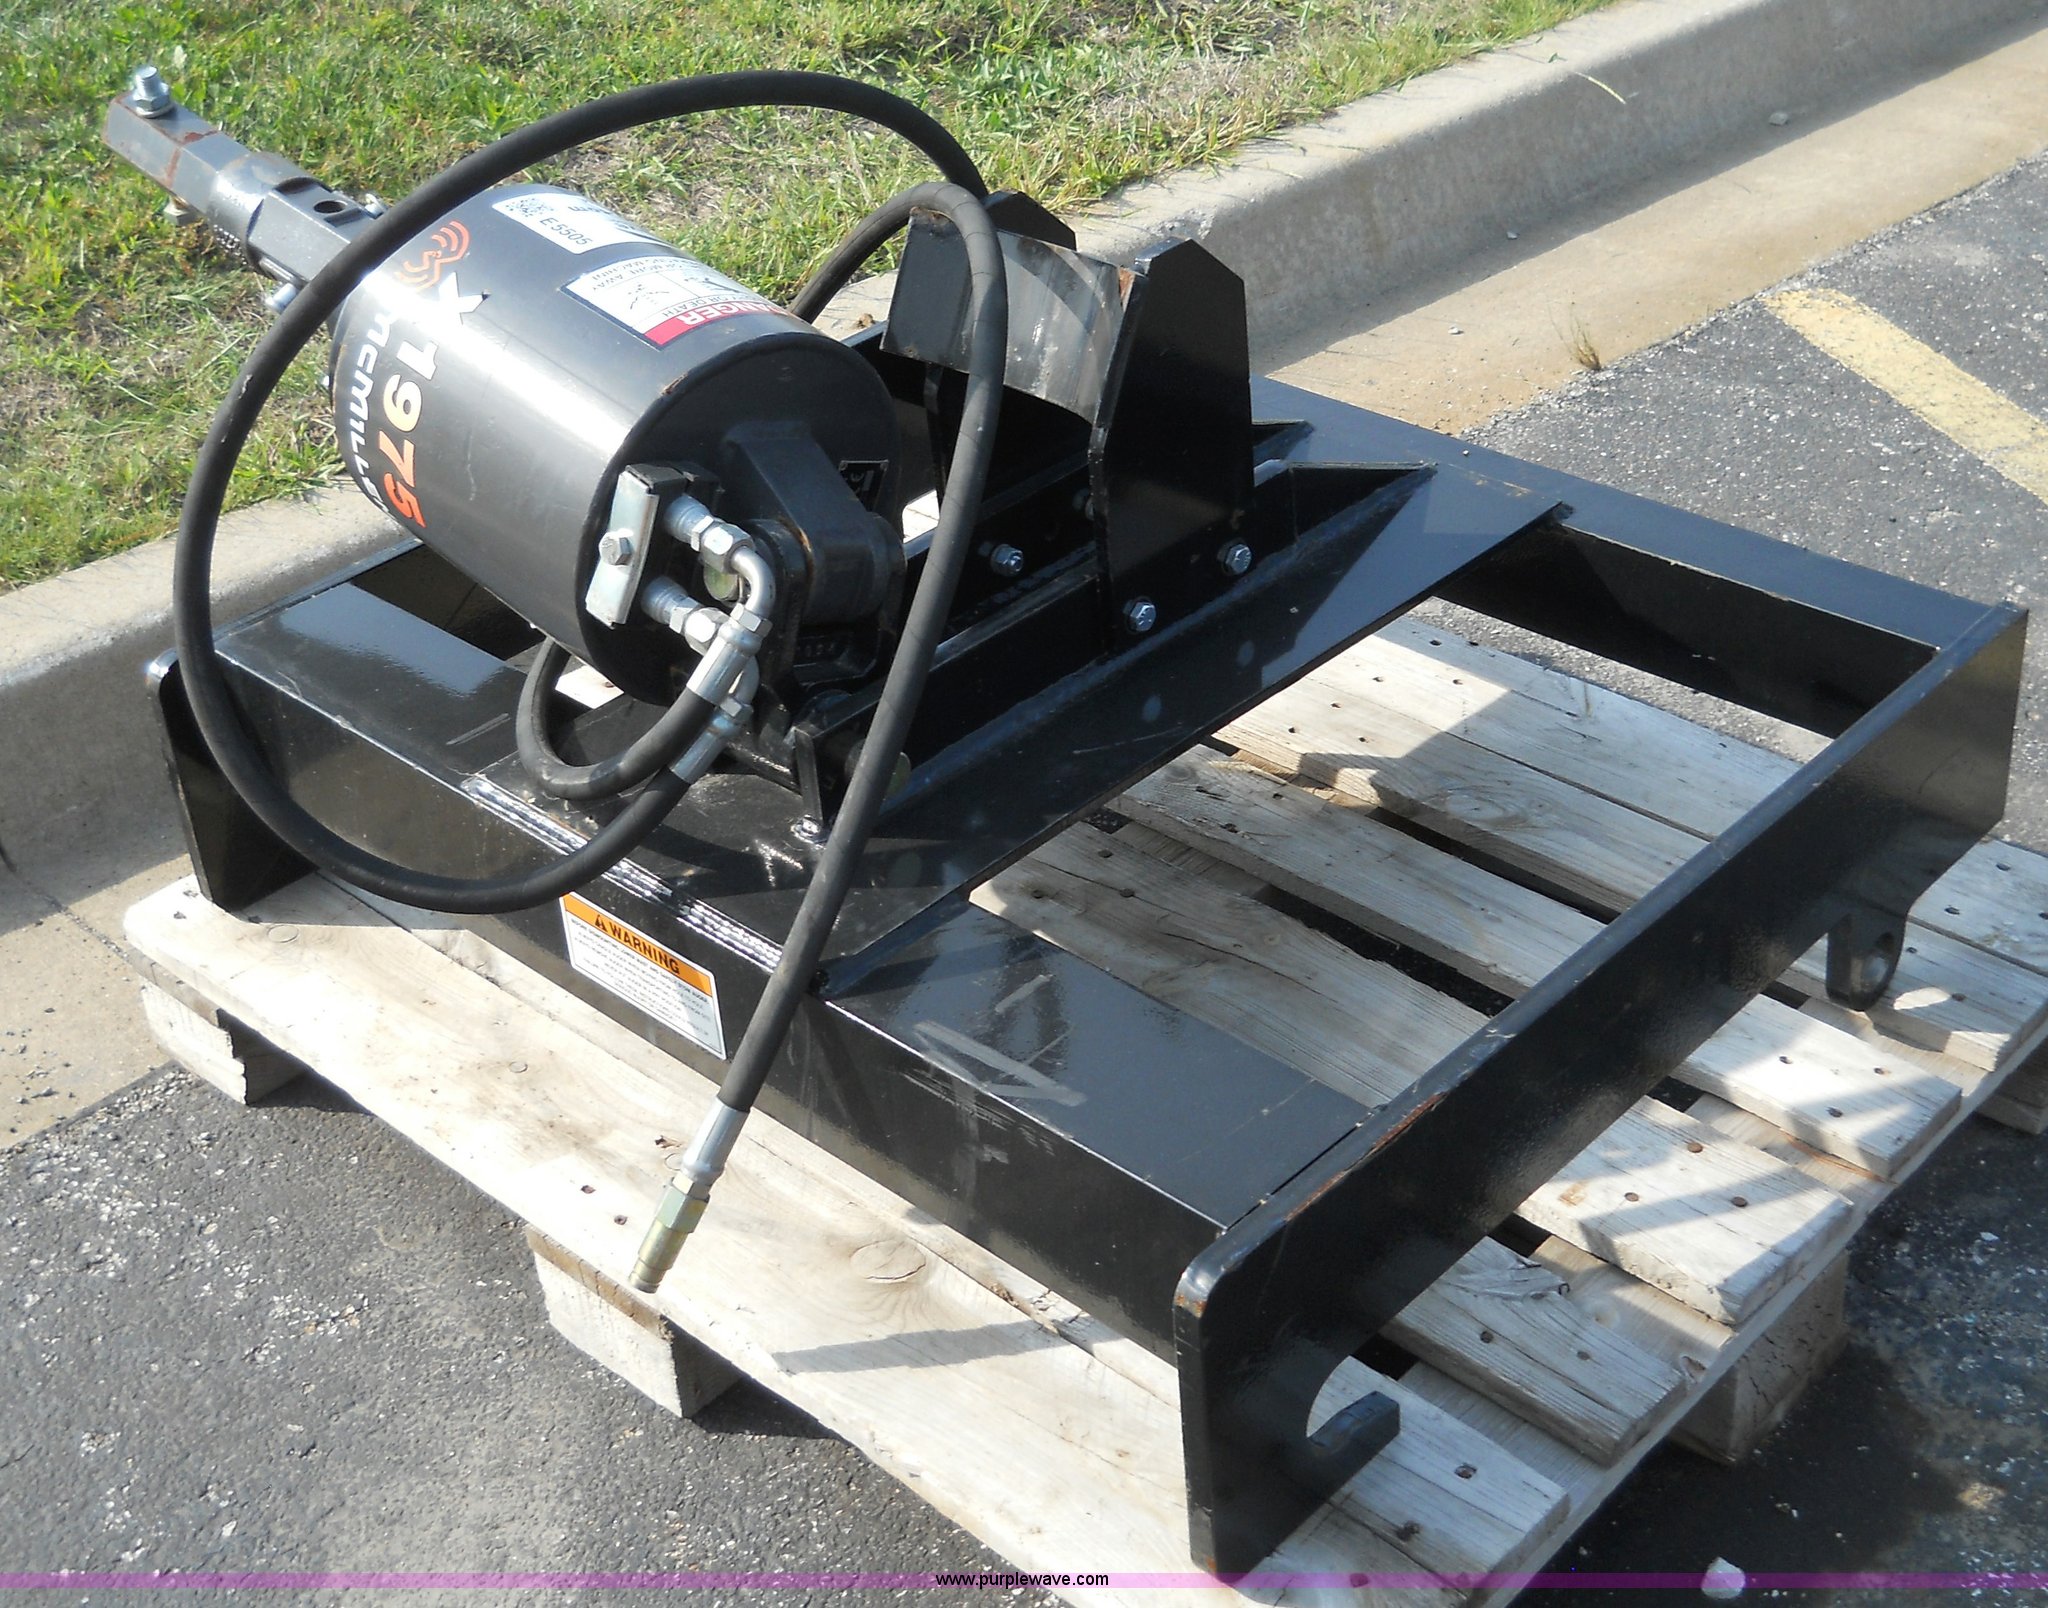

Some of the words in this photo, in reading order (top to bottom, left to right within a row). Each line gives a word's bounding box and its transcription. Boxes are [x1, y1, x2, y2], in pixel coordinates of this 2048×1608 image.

[539, 217, 593, 246] E5505
[662, 300, 708, 318] DEATH
[609, 921, 680, 975] WARNING
